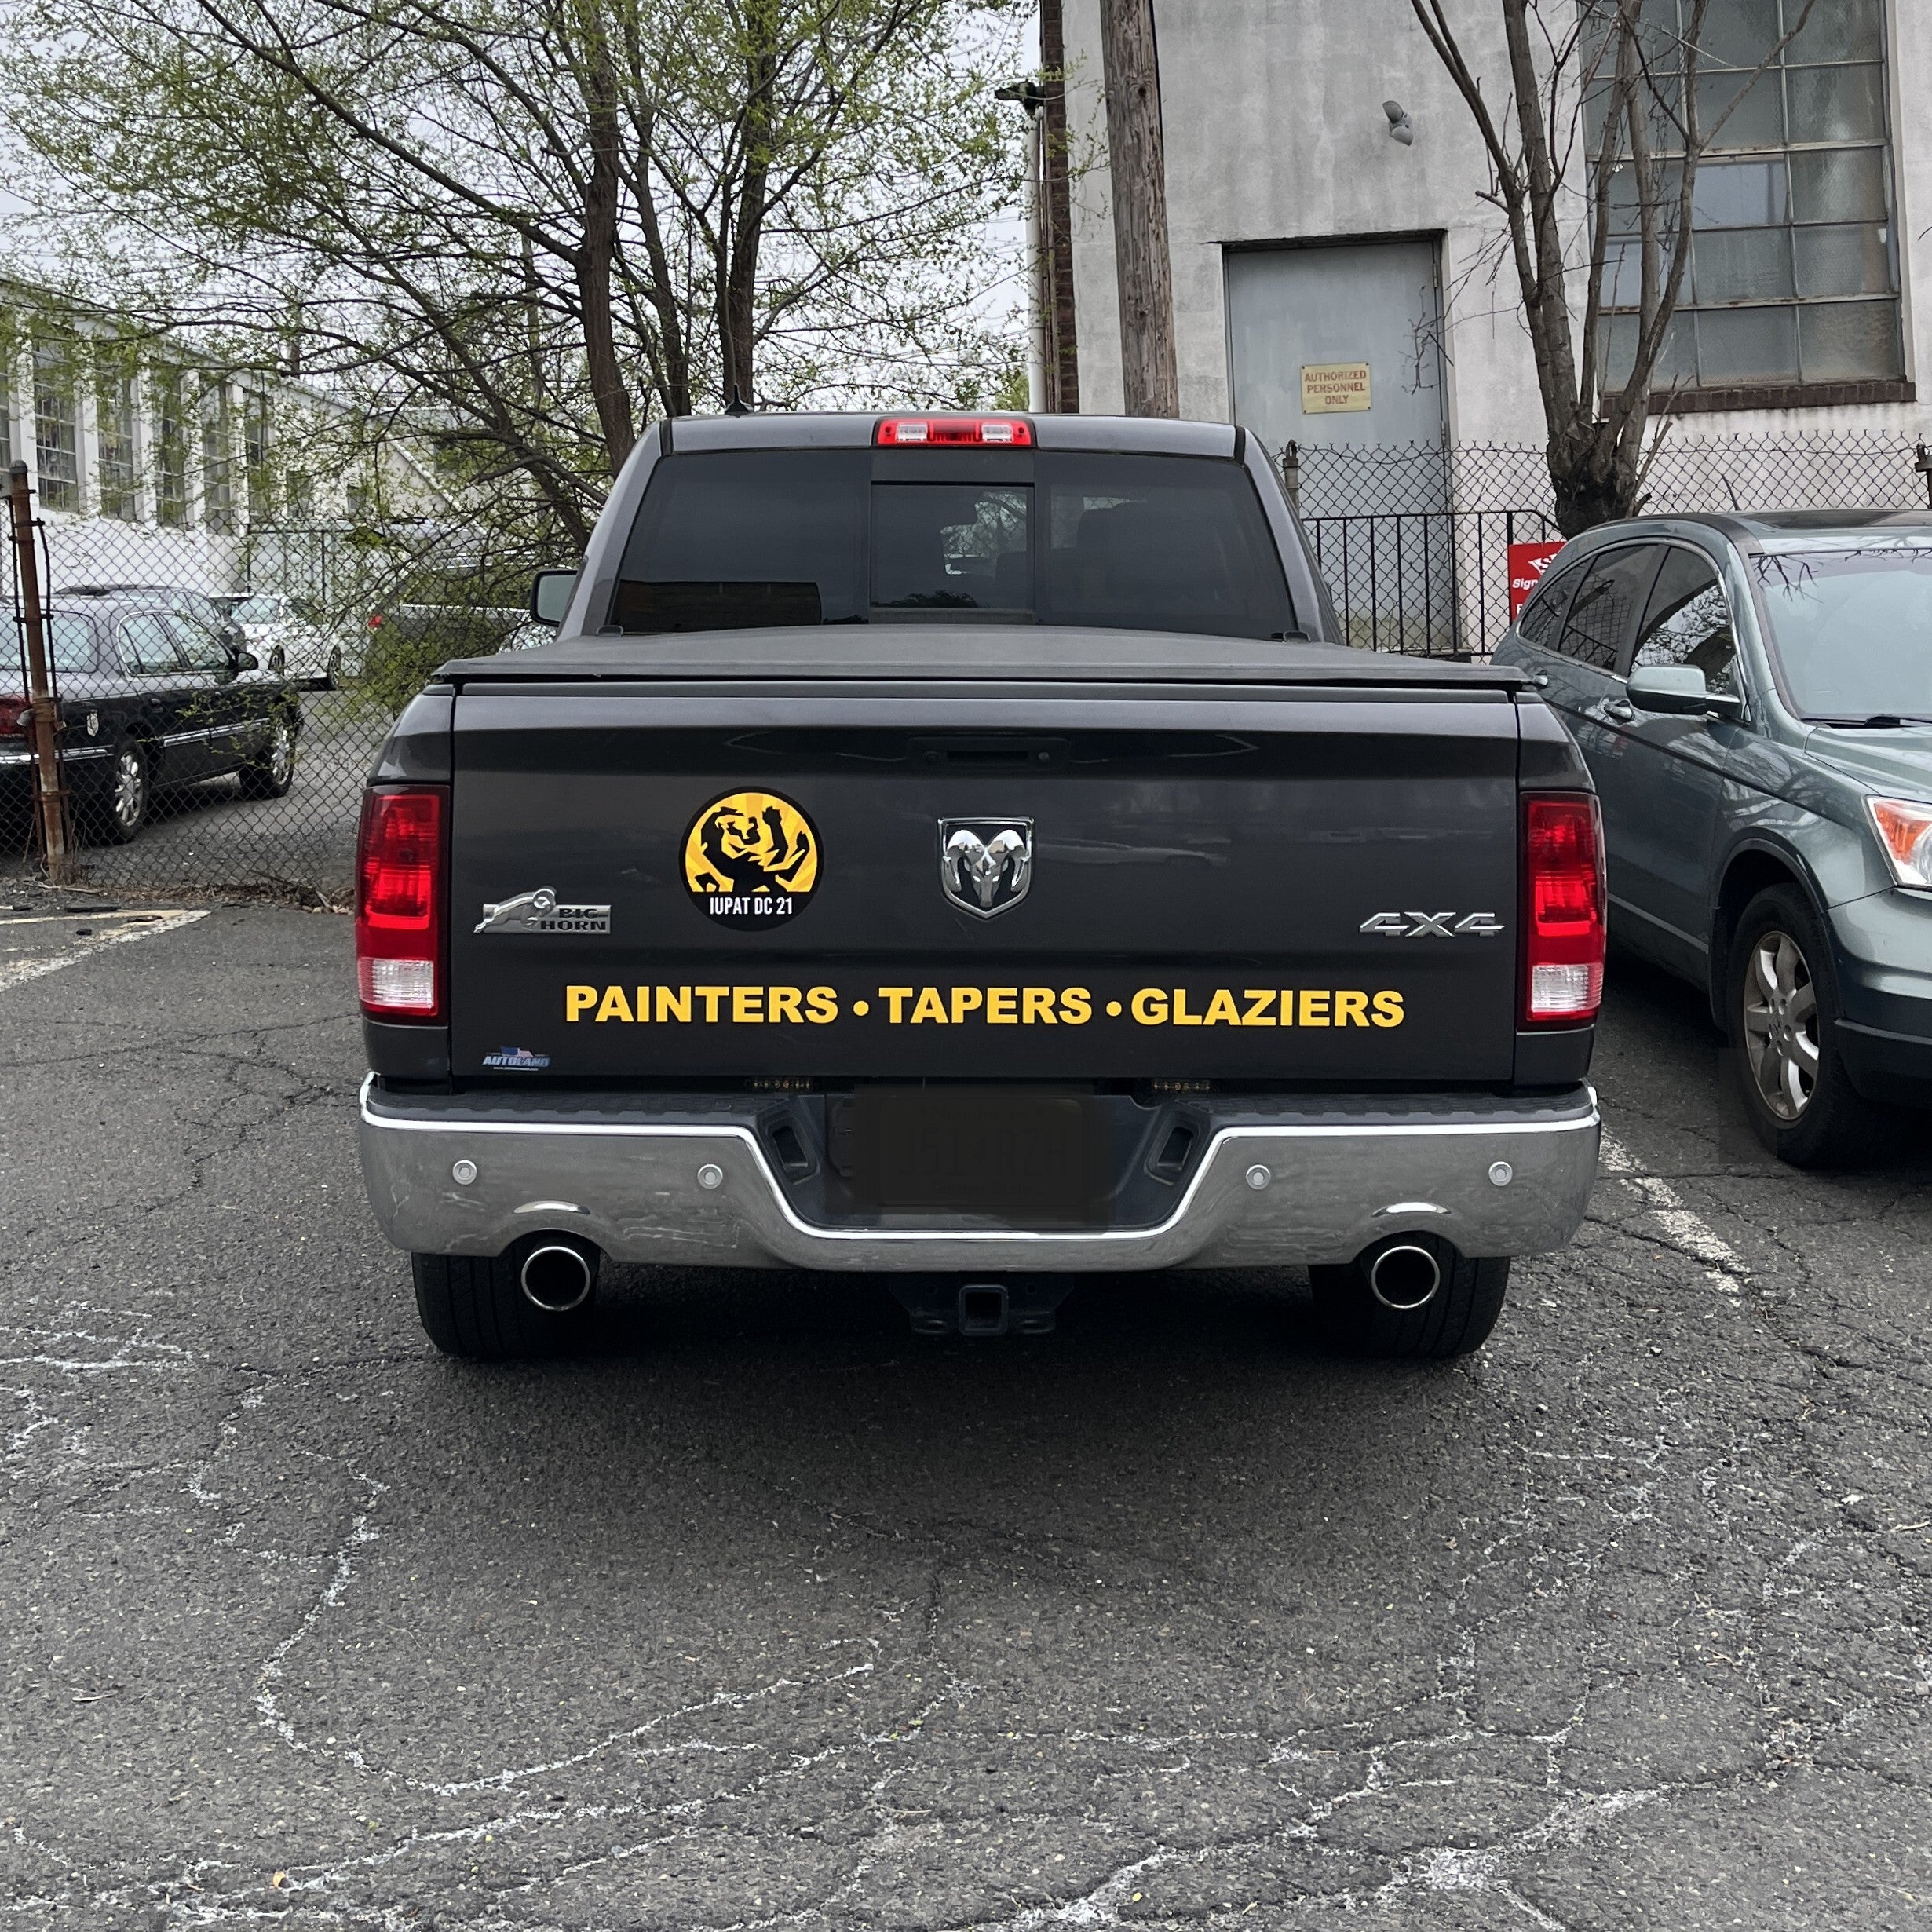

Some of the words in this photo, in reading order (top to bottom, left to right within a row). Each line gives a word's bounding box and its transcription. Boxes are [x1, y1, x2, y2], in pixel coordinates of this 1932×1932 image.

[1305, 370, 1367, 382] AUTHORIZED
[1307, 382, 1365, 393] PERSONNEL
[1324, 394, 1349, 404] ONLY
[710, 897, 751, 915] IUPAT
[754, 897, 773, 915] DC
[776, 897, 793, 915] 21
[558, 908, 598, 919] BIG
[540, 920, 607, 931] HORN
[566, 985, 838, 1023] PAINTERS
[878, 987, 1092, 1025] TAPERS
[1130, 988, 1405, 1028] GLAZIERS
[482, 1055, 551, 1068] AUTOLAND
